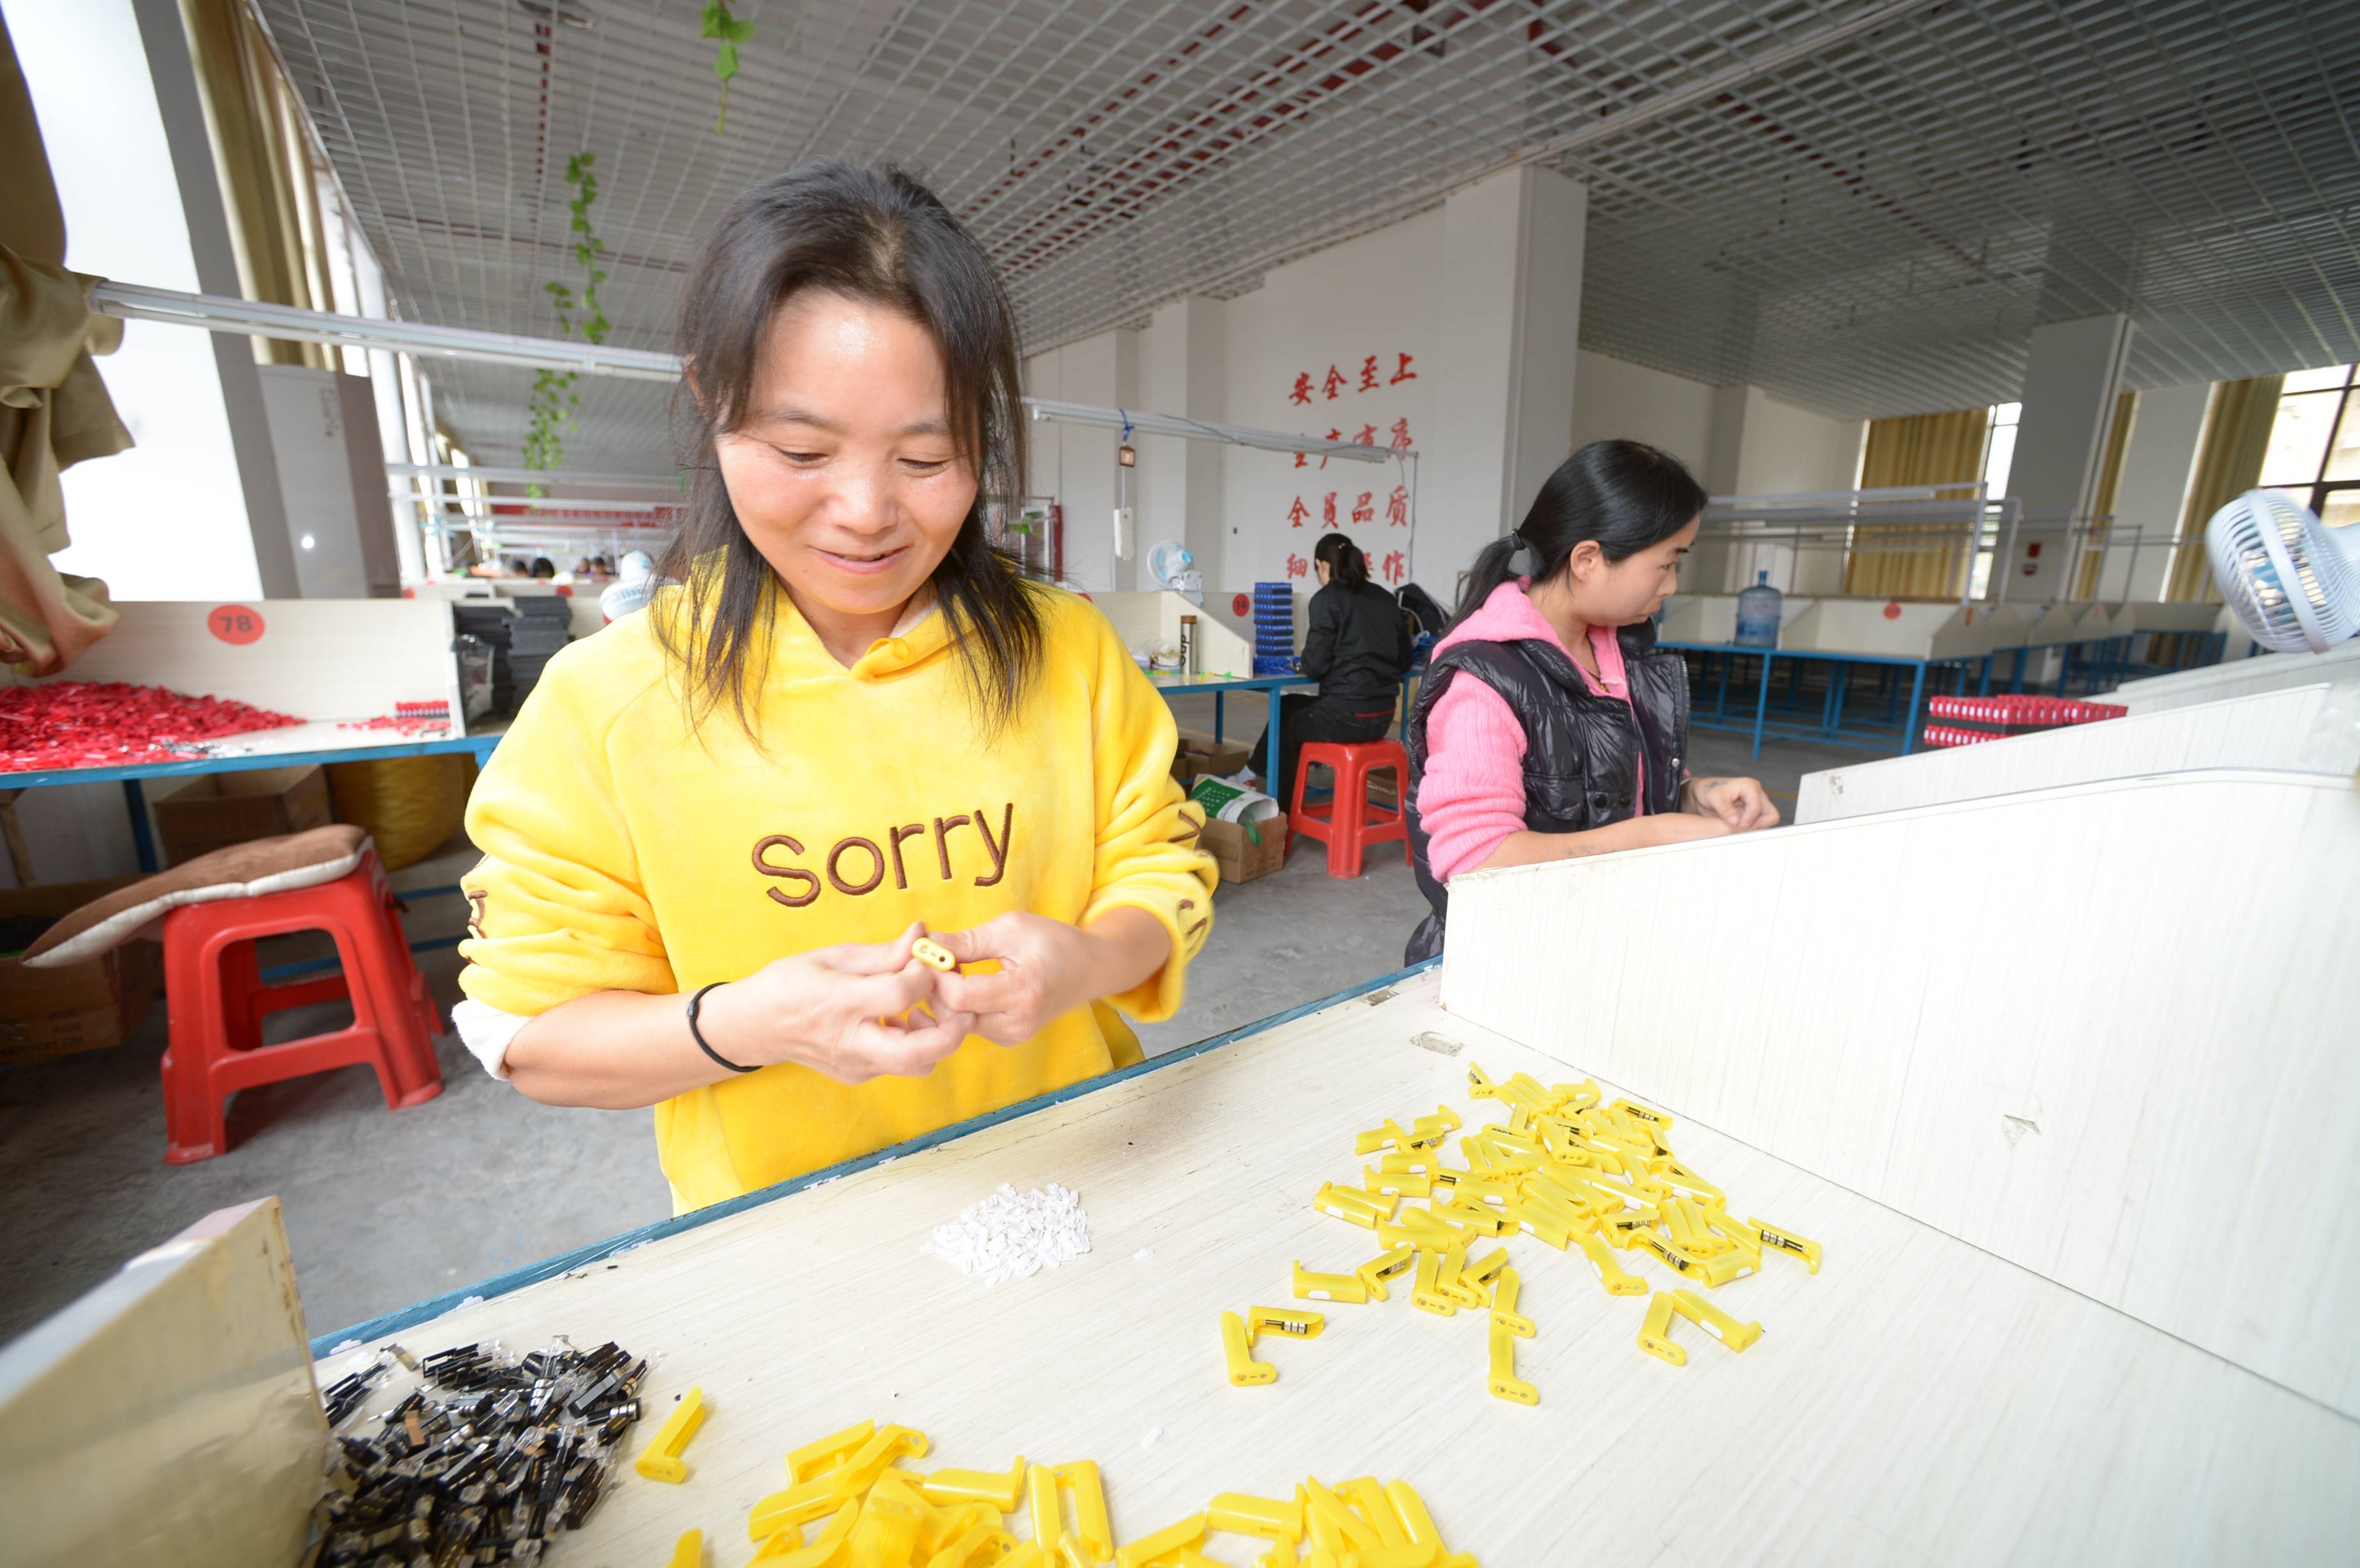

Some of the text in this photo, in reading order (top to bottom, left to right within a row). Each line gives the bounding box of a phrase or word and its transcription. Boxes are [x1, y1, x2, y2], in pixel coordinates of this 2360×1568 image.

[1289, 352, 1418, 406] 安全至上
[1236, 600, 1246, 610] 74
[217, 615, 253, 633] 78
